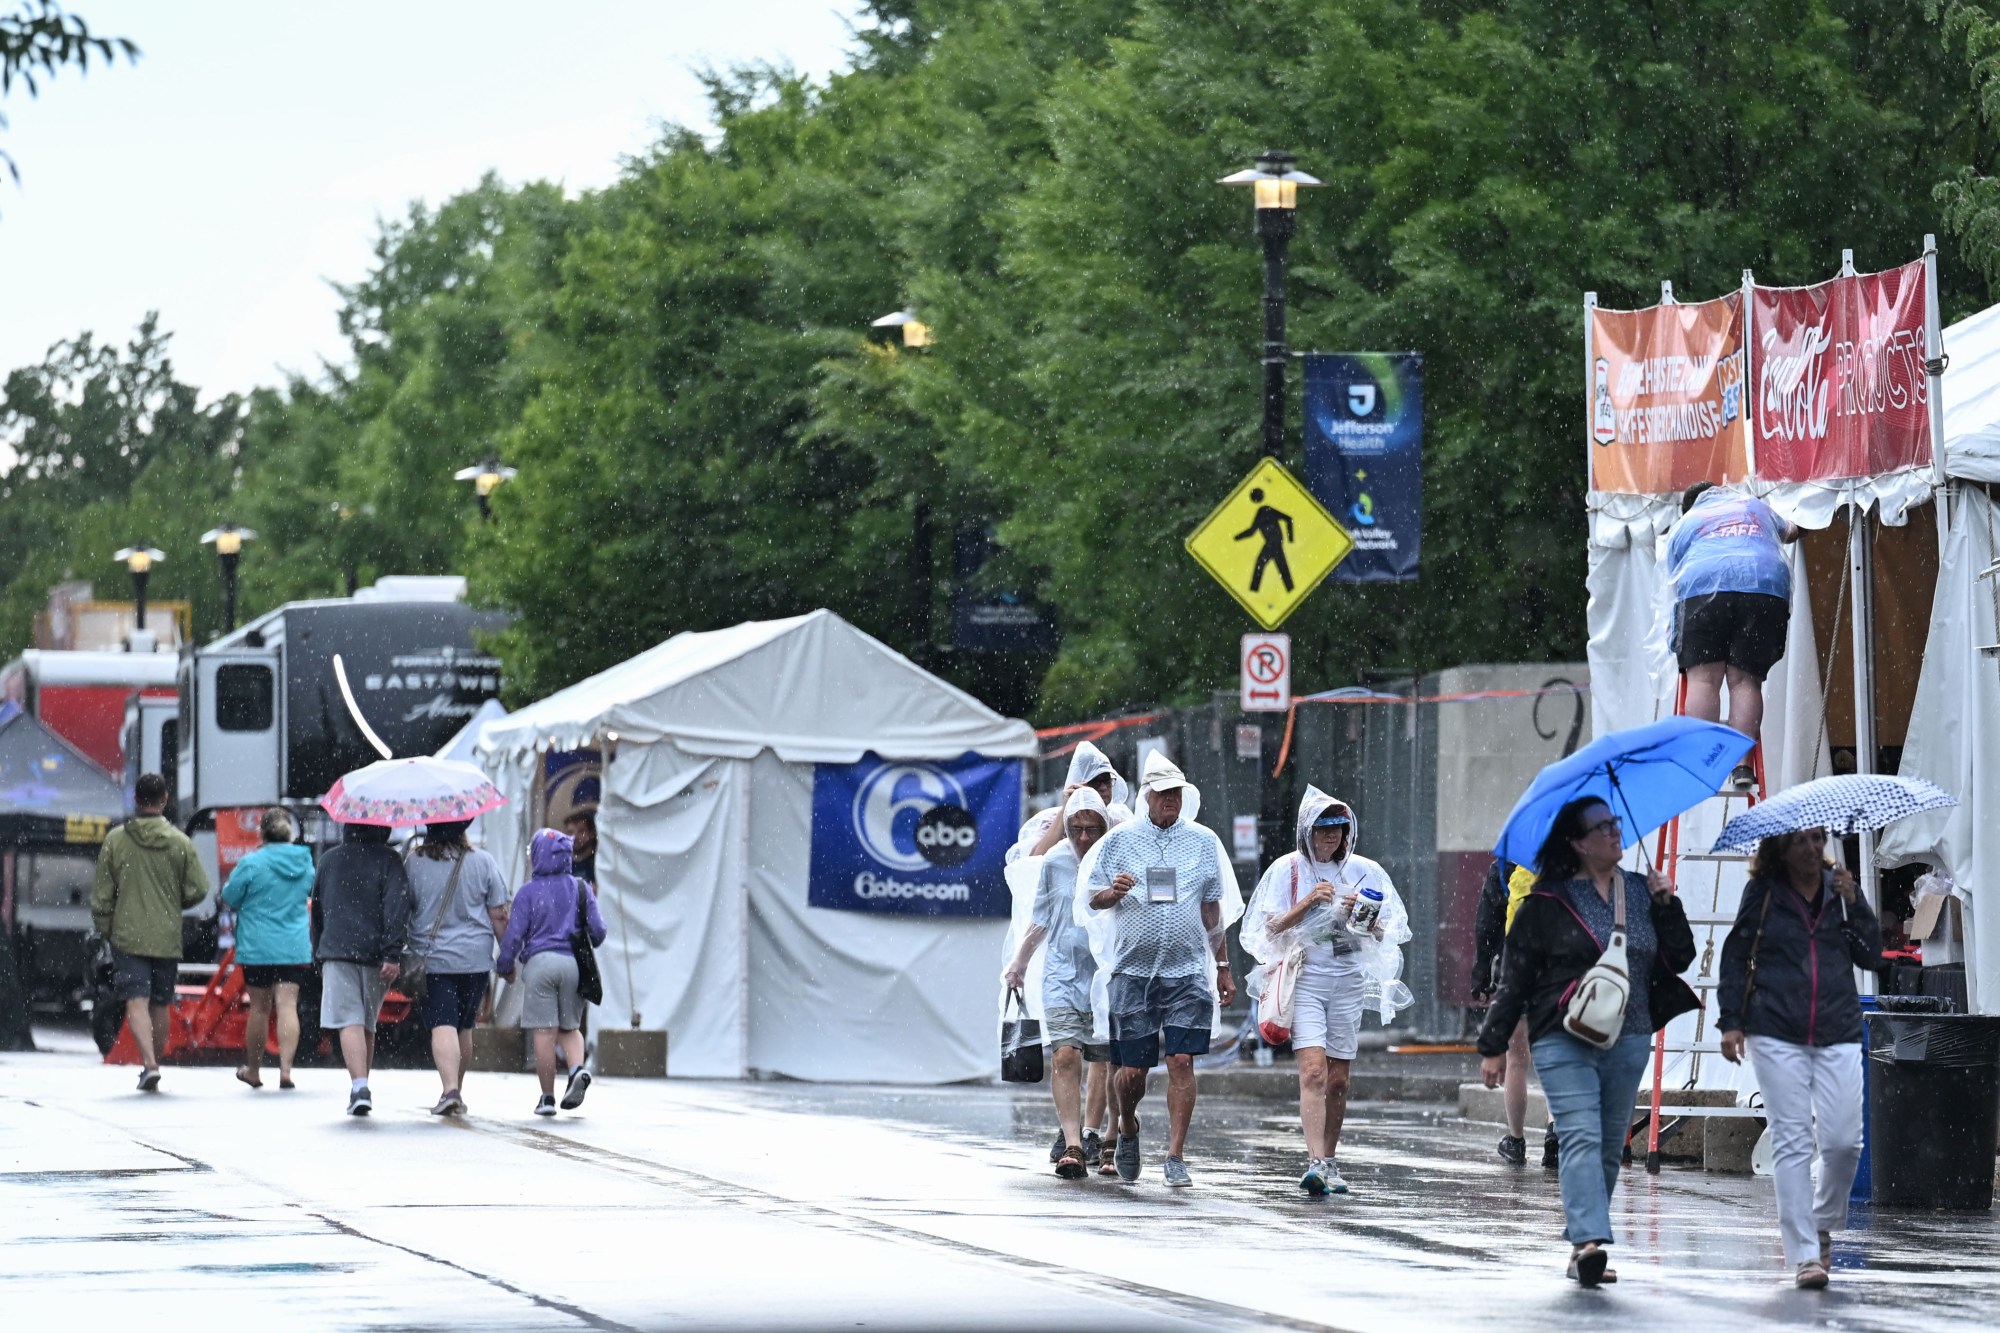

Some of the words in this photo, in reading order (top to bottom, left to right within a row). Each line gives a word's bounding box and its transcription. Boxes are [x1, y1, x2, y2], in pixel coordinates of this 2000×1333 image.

[1836, 325, 1927, 417] PRODUCTS
[1330, 420, 1394, 435] Jefferson
[1338, 436, 1385, 449] Health
[365, 674, 438, 690] EAST
[916, 821, 976, 847] abc
